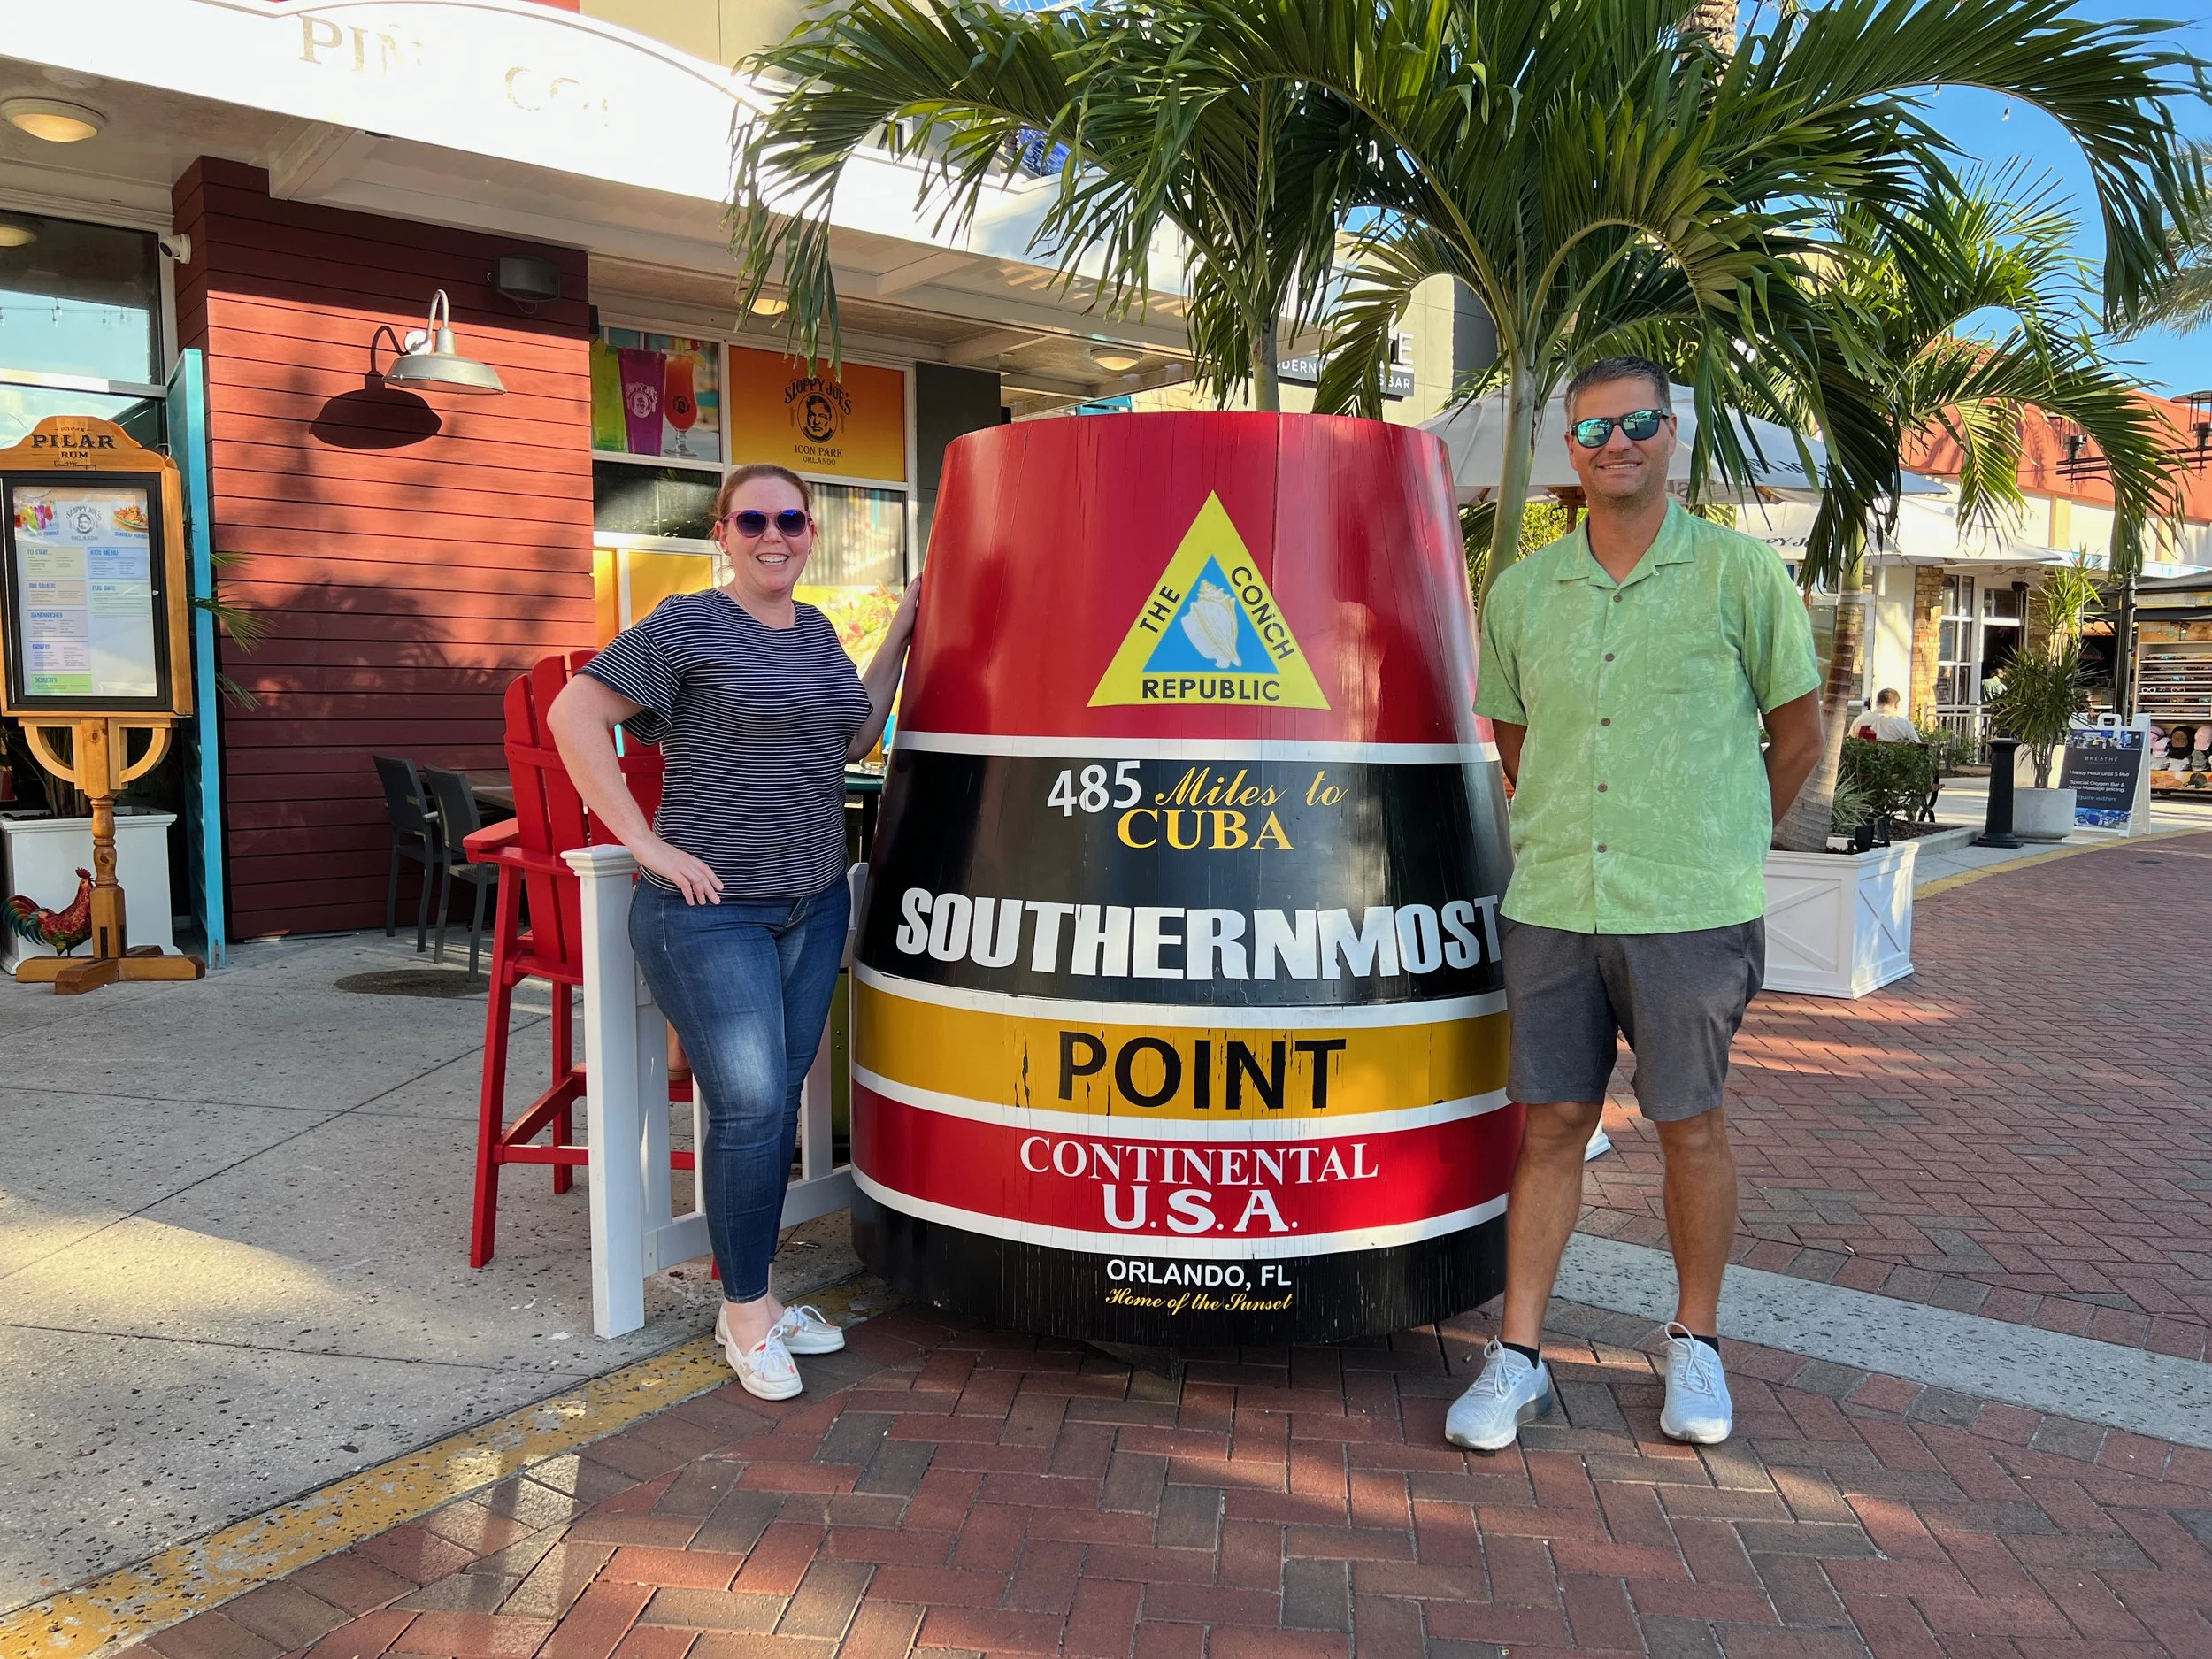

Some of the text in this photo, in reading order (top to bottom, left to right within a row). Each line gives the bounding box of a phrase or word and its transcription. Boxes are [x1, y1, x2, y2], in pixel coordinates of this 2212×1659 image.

[1277, 359, 1317, 375] DERN
[785, 378, 851, 415] SLOPPY JOE'S
[32, 434, 117, 449] PILAR
[795, 444, 843, 457] ICON PARK
[803, 456, 836, 465] ORLANDO
[1139, 586, 1180, 634] THE
[1232, 566, 1294, 660] CONCH
[1141, 679, 1281, 702] REPUBLIC
[1047, 760, 1349, 817] 485 Miles to
[1117, 808, 1295, 850] CUBA
[895, 887, 1502, 980] SOUTHERNMOST
[1058, 1031, 1346, 1110] POINT
[1019, 1136, 1379, 1185] CONTINENTAL
[1102, 1183, 1299, 1234] U.S.A.
[1106, 1258, 1292, 1292] ORLANDO, FL
[1105, 1287, 1294, 1316] Home of the Sunset
